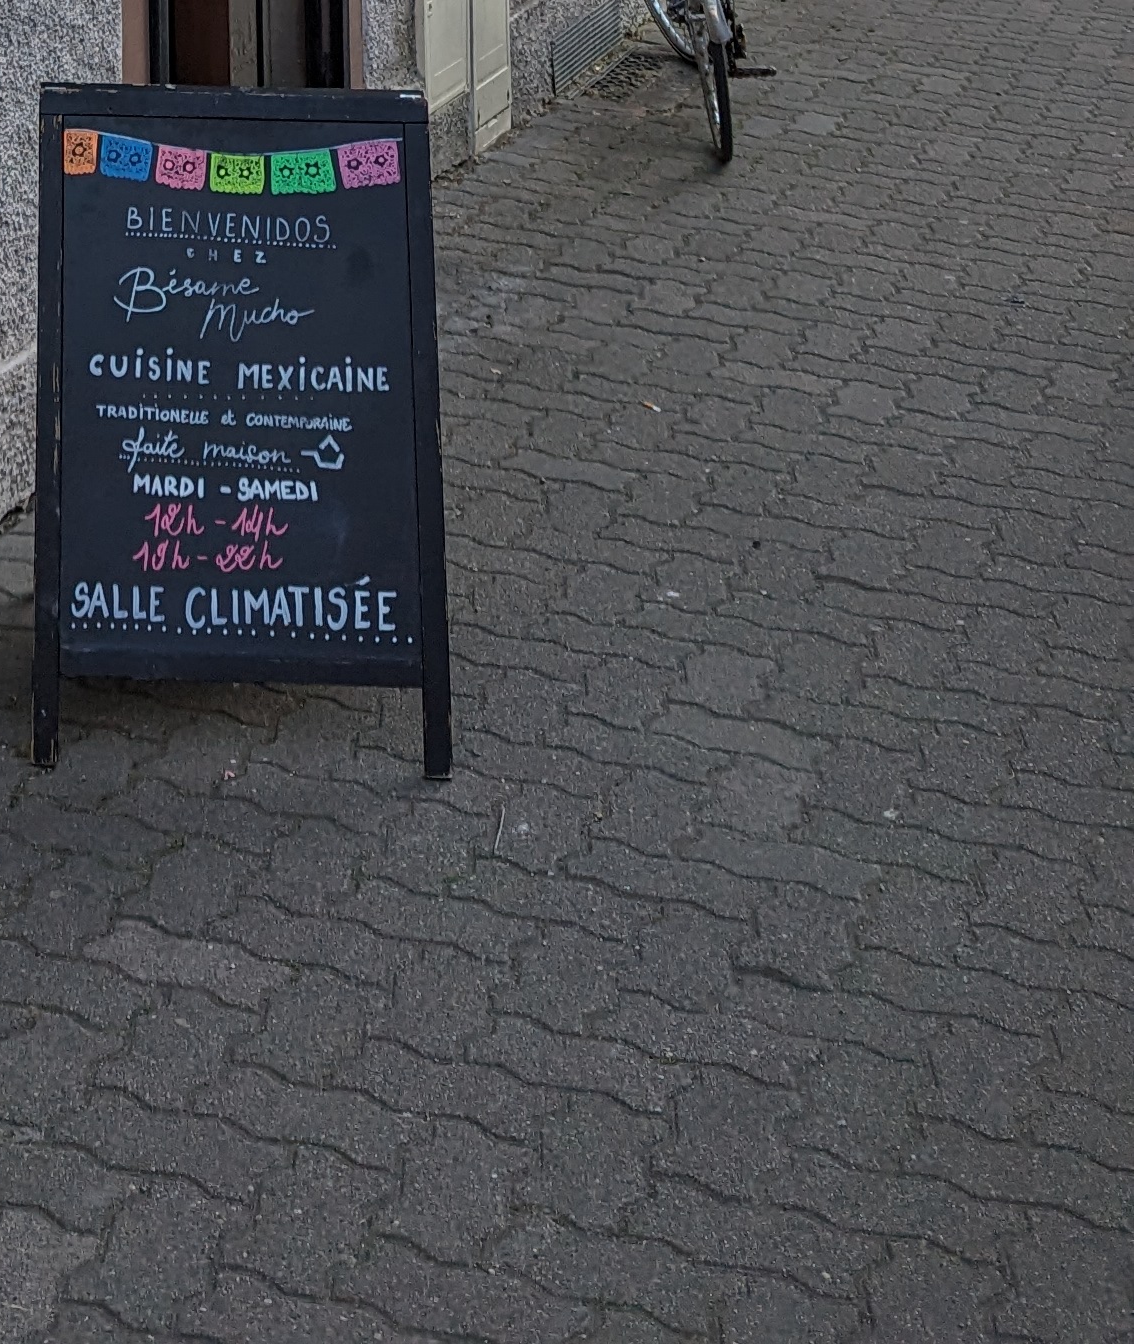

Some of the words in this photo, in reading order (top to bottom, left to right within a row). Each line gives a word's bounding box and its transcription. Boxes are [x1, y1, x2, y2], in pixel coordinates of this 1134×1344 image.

[125, 206, 332, 243] BIENVENIDOS
[112, 265, 260, 322] Bésame
[199, 297, 315, 342] Mucho
[220, 408, 237, 426] et
[121, 425, 186, 474] faite
[202, 440, 292, 464] maison
[133, 472, 206, 499] MARDI
[236, 476, 319, 503] SAMEDI
[71, 581, 166, 623] SALLE
[184, 575, 398, 632] CLIMATISÉE
